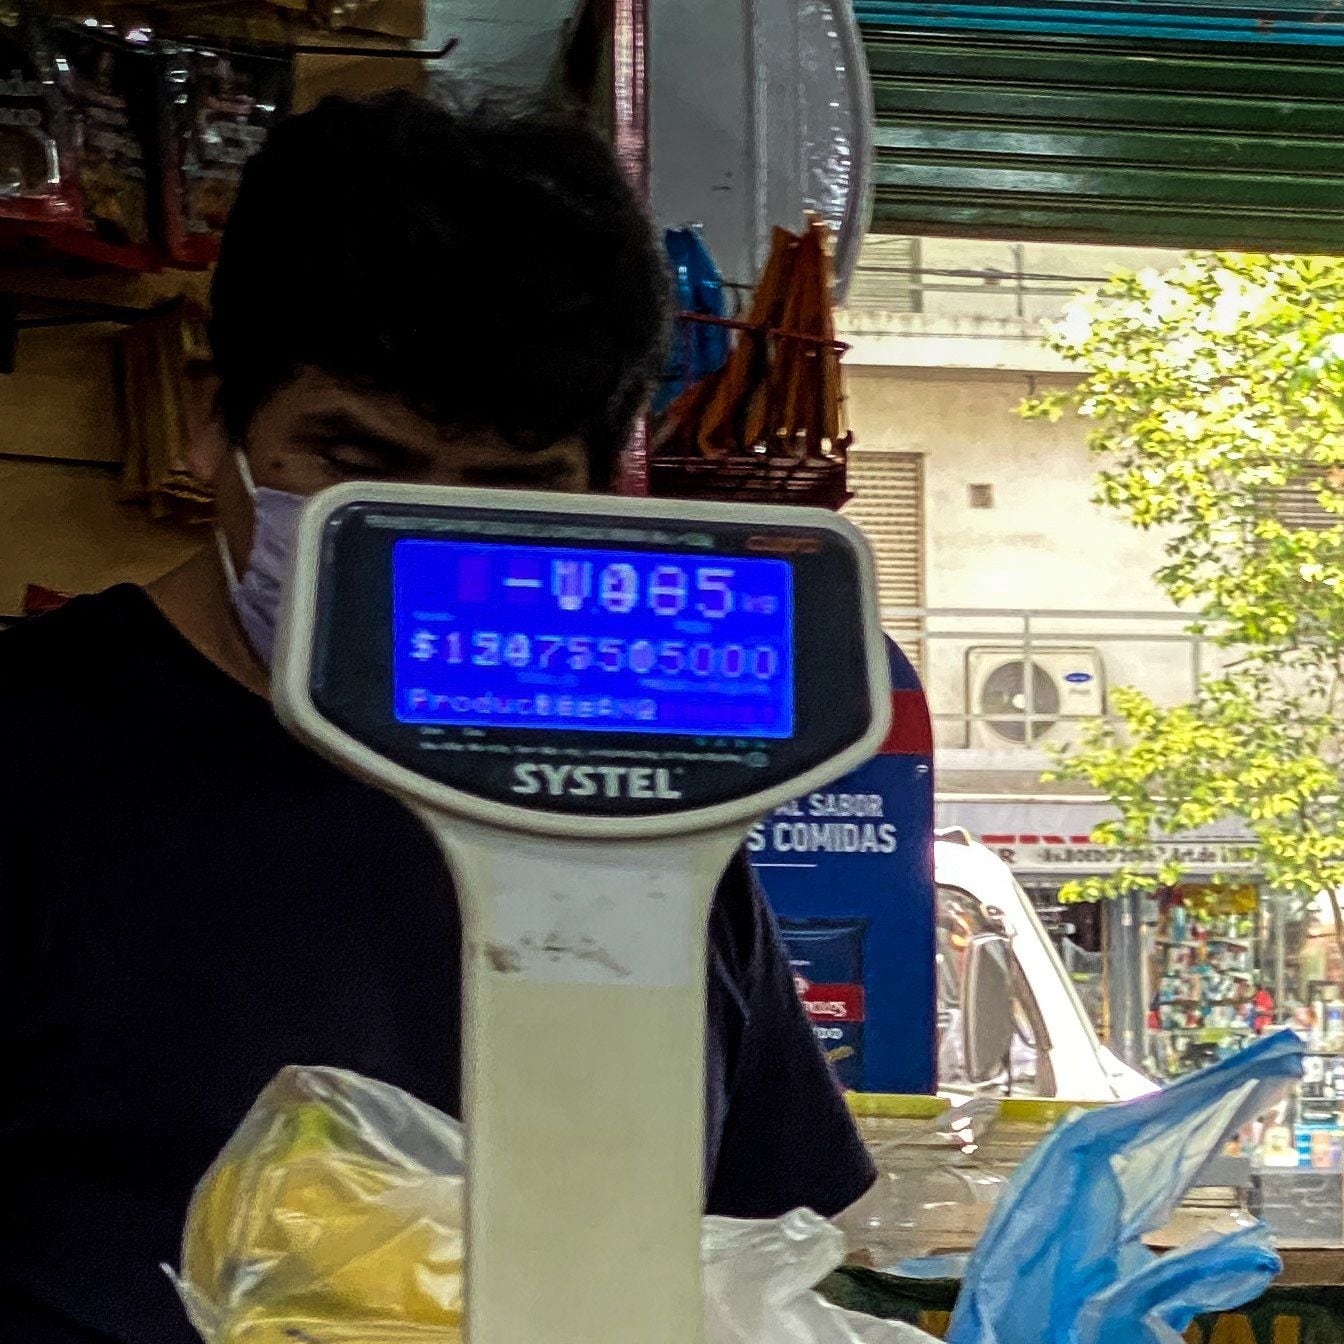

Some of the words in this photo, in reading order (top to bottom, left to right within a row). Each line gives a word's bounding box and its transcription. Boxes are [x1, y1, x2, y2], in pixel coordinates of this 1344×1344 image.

[511, 763, 682, 800] SYSTEL
[808, 792, 884, 818] SABOR
[773, 822, 898, 854] COMIDAS
